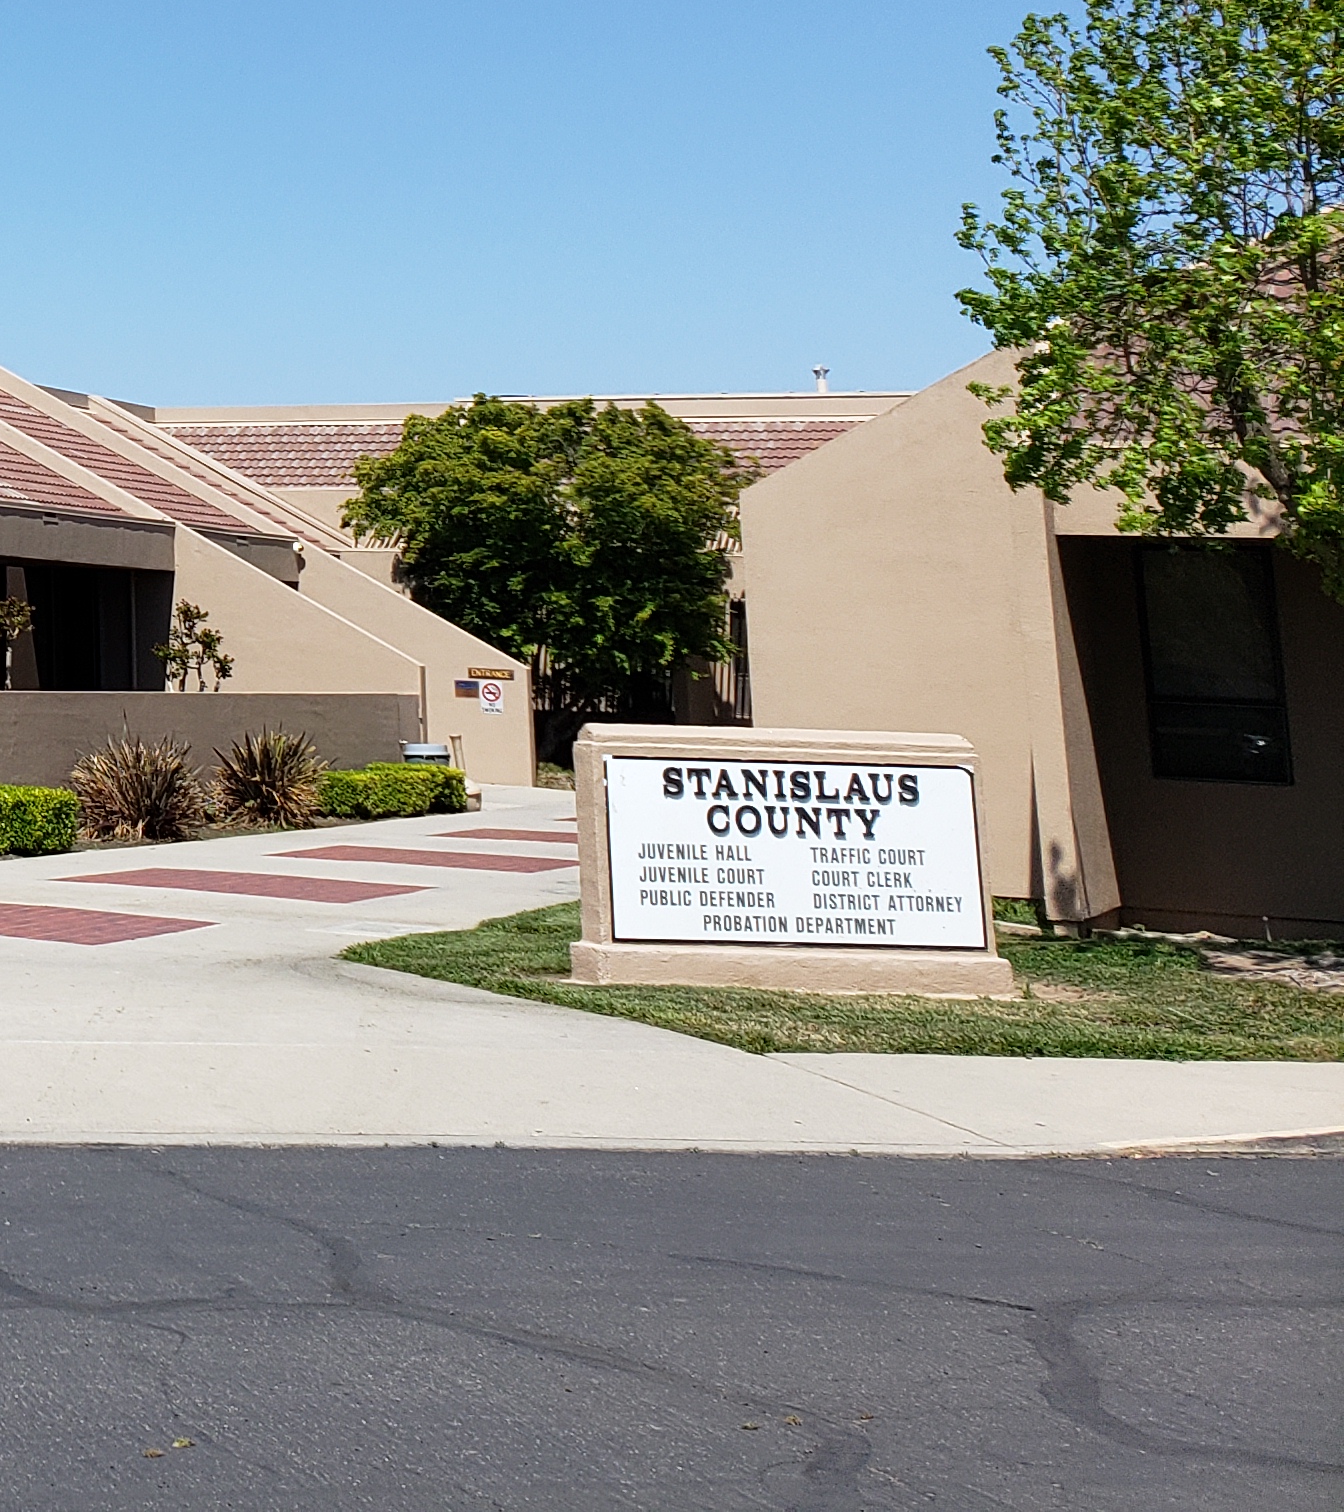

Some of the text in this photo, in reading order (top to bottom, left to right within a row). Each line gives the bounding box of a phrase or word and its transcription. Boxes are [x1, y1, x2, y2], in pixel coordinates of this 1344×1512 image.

[471, 669, 511, 678] ENTRANCE
[663, 767, 920, 806] STANISLAUS
[707, 805, 880, 840] COUNTY
[638, 843, 752, 862] JUVENILE HALL
[811, 847, 926, 866] TRAFFIC COURT
[639, 867, 764, 886] JUVENILE COURT
[812, 870, 913, 889] COURT CLERK
[640, 890, 775, 909] PUBLIC DEFENDER
[813, 894, 963, 913] DISTRICT ATTORNEY
[703, 915, 896, 935] PROBATION DEPARTMENT
